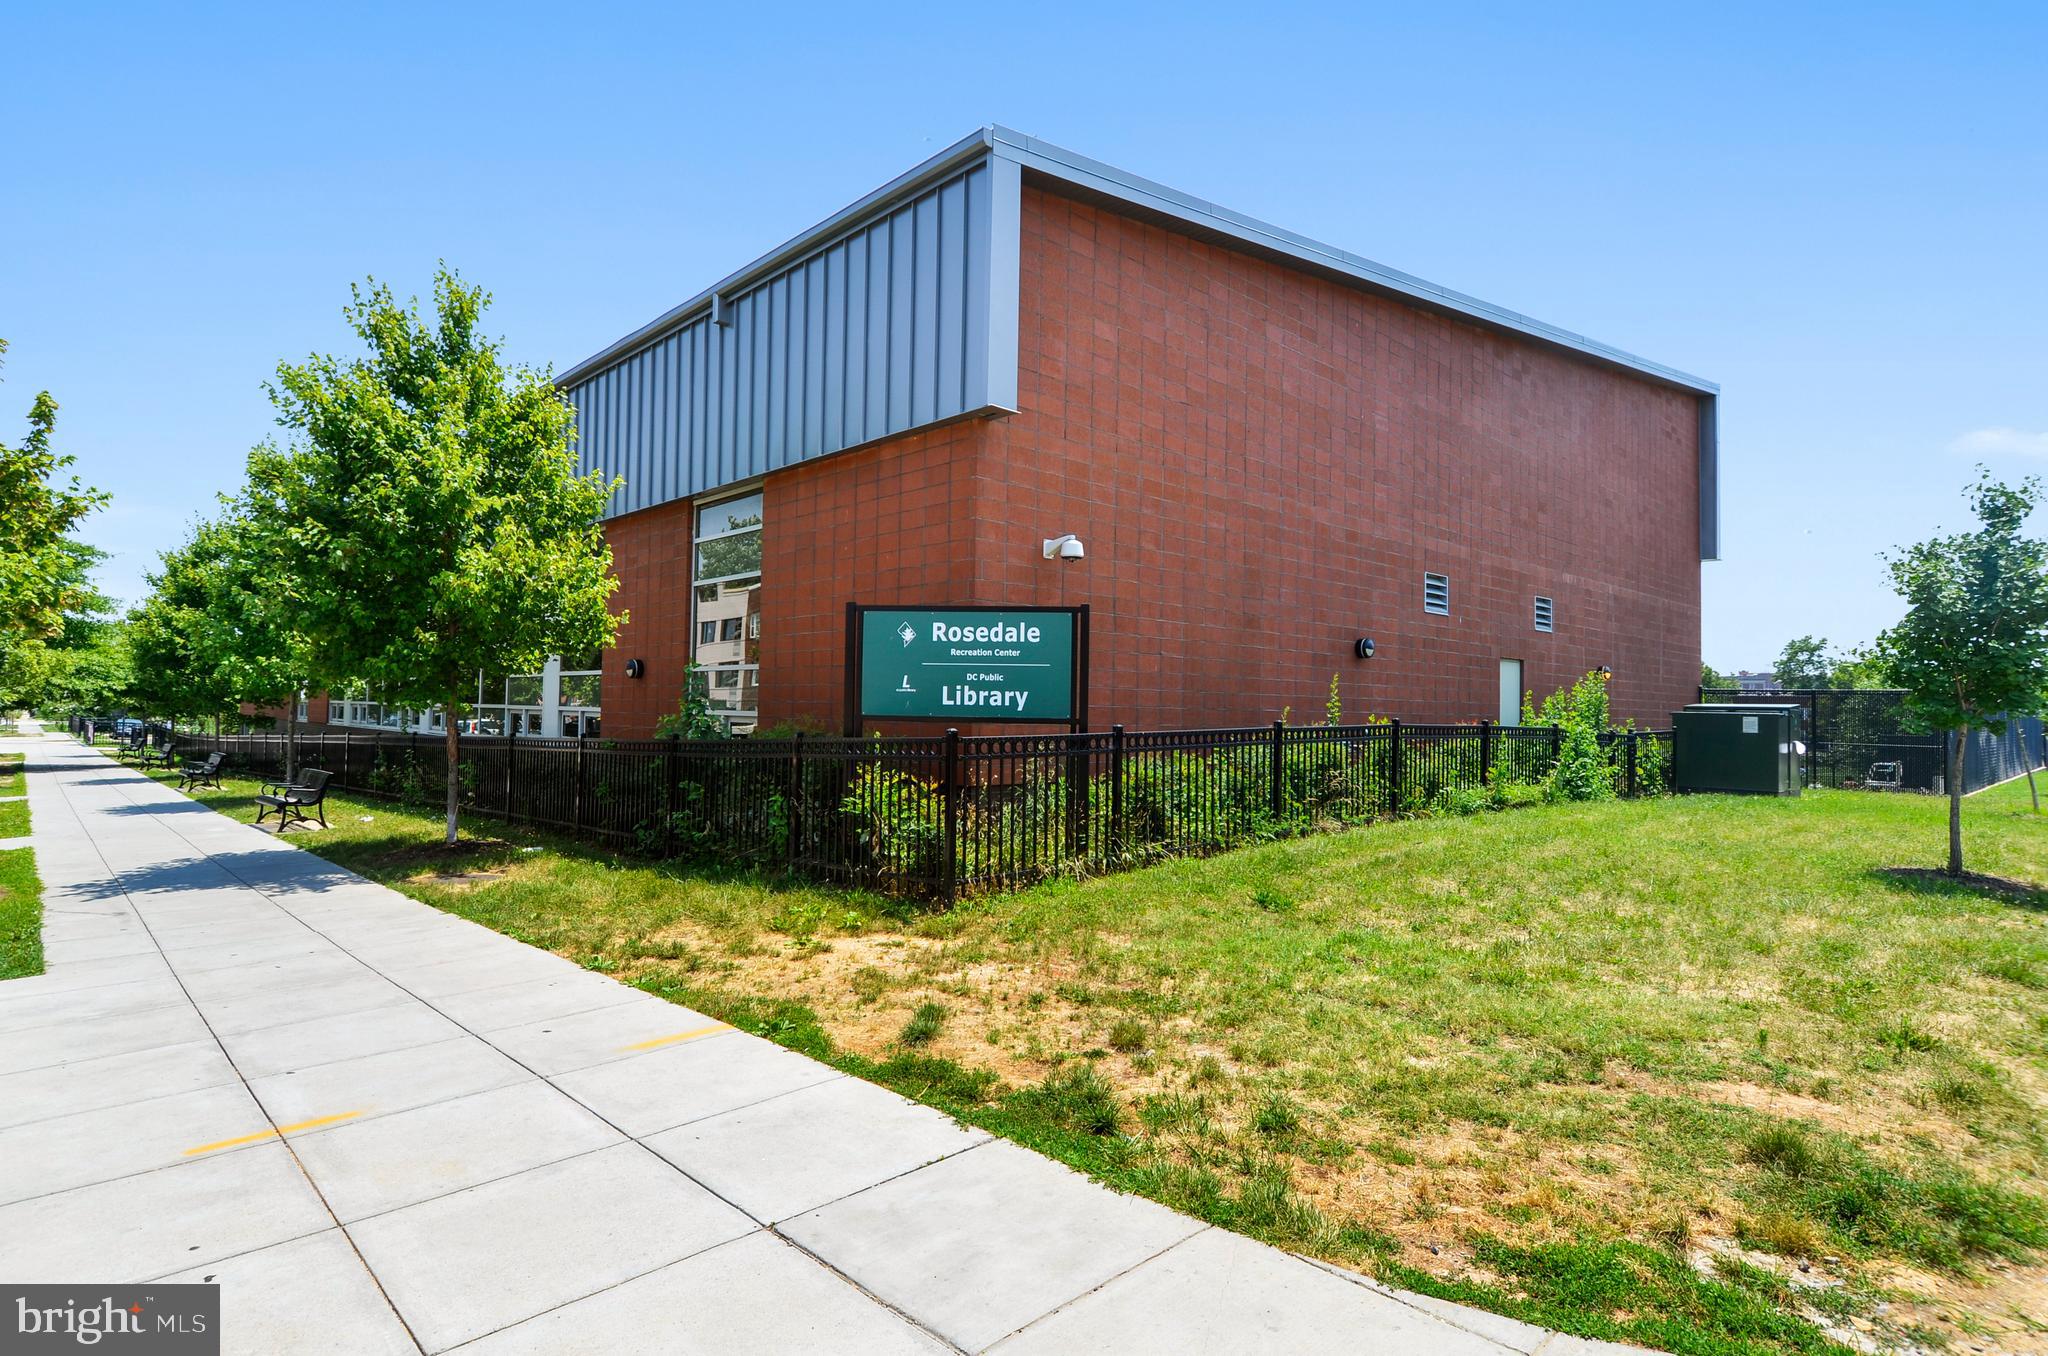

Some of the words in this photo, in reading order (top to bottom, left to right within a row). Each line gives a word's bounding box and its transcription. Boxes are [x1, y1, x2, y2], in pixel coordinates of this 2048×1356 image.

[932, 621, 1041, 643] Rosedale
[950, 648, 993, 657] Recreation
[994, 649, 1021, 657] Center
[902, 674, 911, 688] L
[966, 673, 978, 682] DC
[979, 673, 1004, 682] Public
[942, 685, 1029, 711] Library
